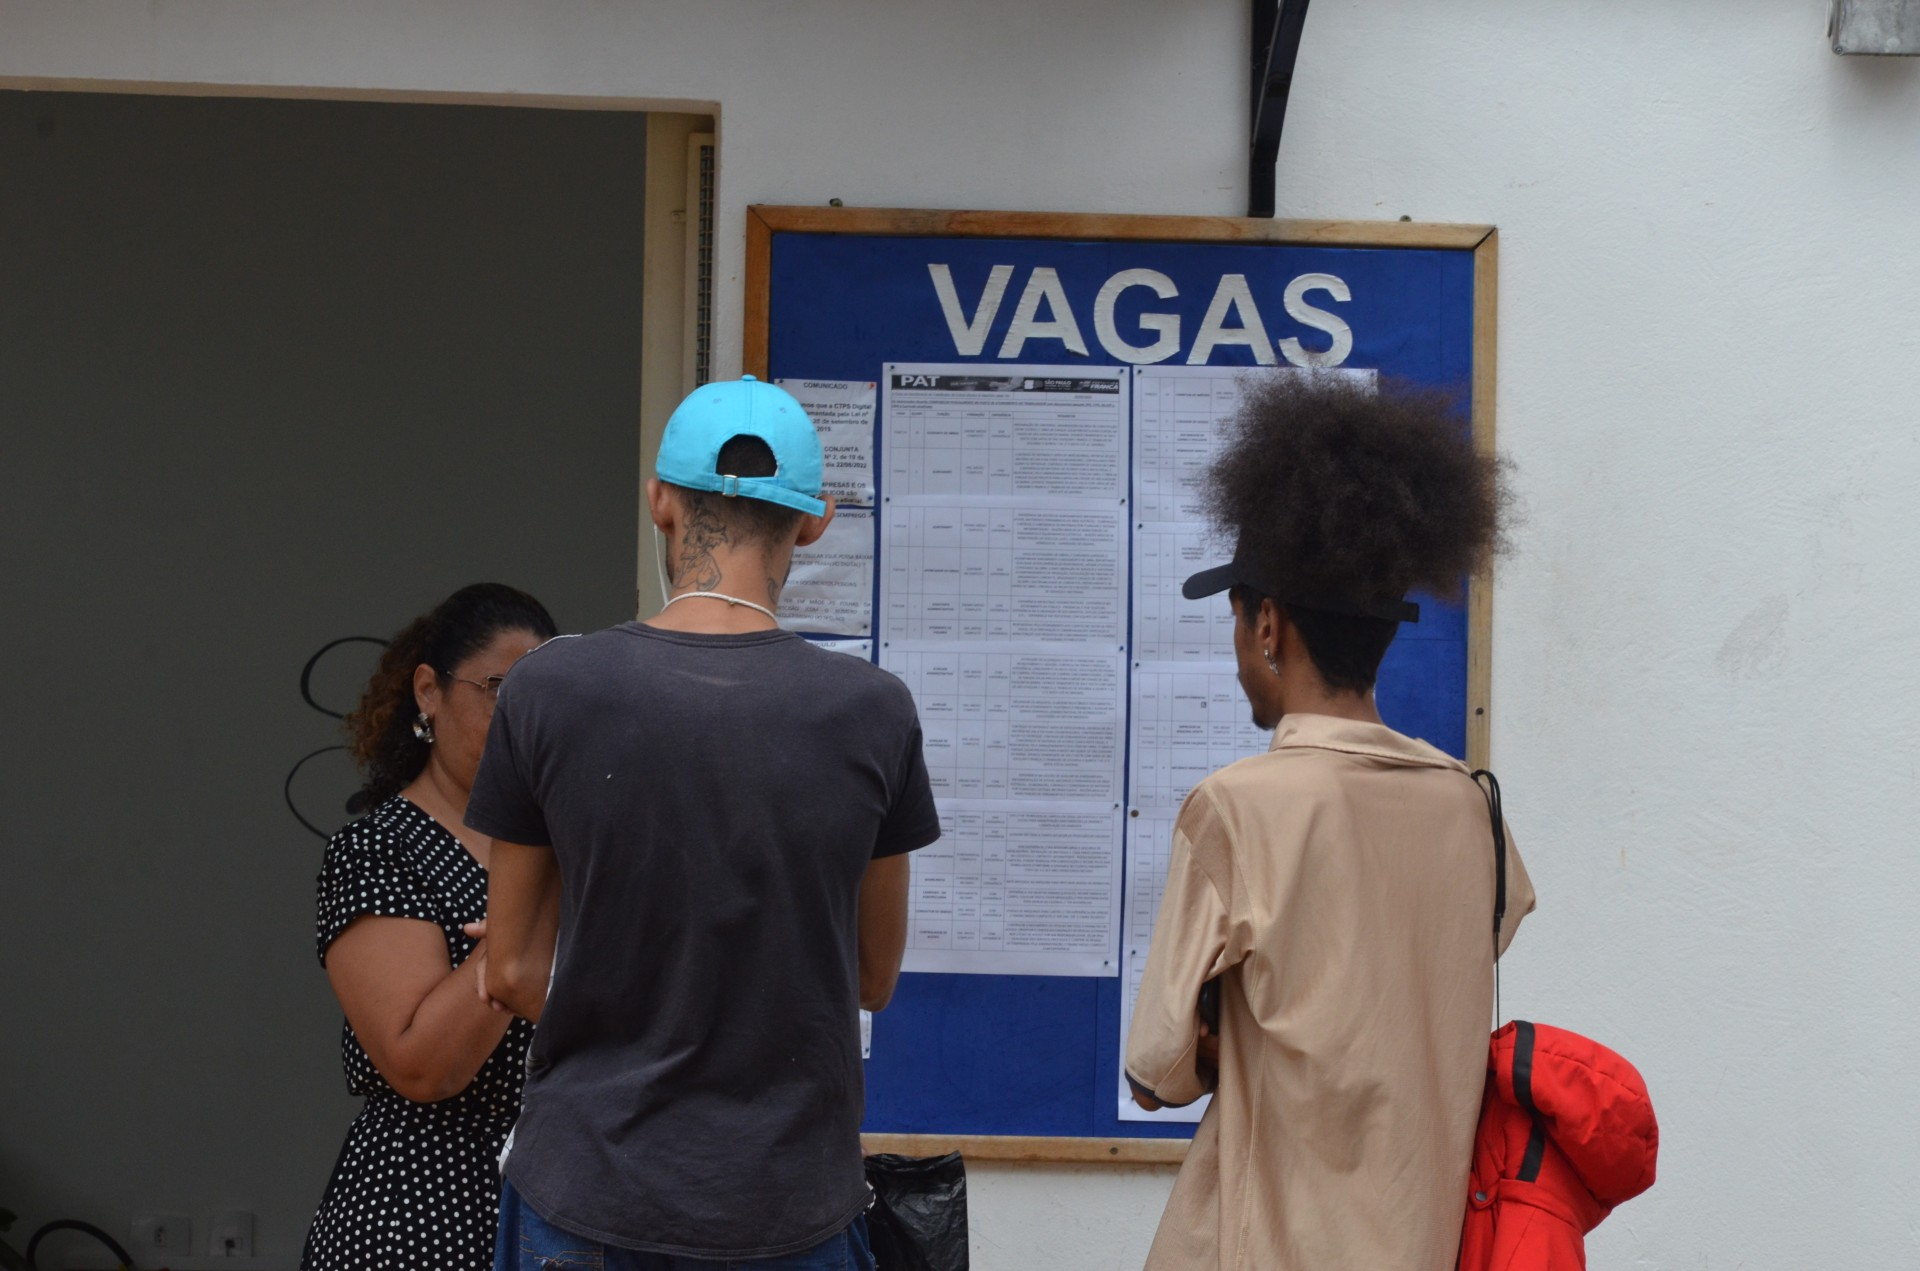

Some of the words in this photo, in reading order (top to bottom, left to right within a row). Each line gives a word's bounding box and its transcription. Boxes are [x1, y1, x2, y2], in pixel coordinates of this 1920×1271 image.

[928, 263, 1353, 368] VAGAS
[803, 382, 848, 390] COMUNICADO
[901, 375, 940, 387] PAT
